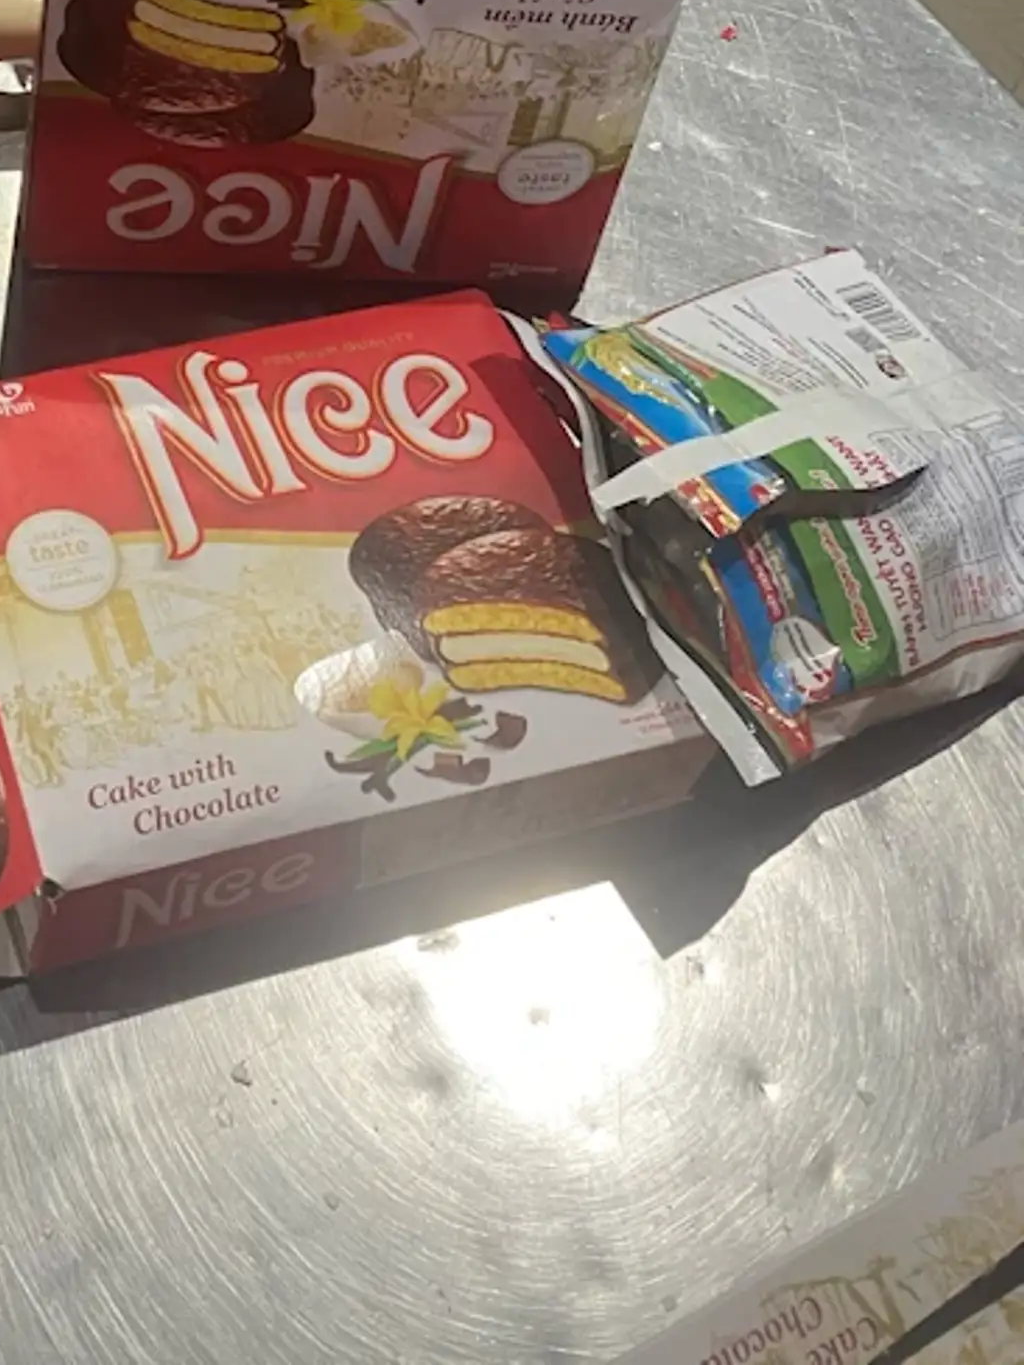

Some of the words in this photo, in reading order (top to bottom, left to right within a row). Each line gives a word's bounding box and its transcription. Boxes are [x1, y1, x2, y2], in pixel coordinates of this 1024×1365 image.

[105, 153, 458, 273] Nice
[99, 348, 496, 562] Nice
[28, 538, 90, 563] taste
[86, 772, 165, 812] Cake
[169, 753, 237, 794] with
[131, 779, 282, 838] Chocolate
[115, 847, 316, 948] Nice
